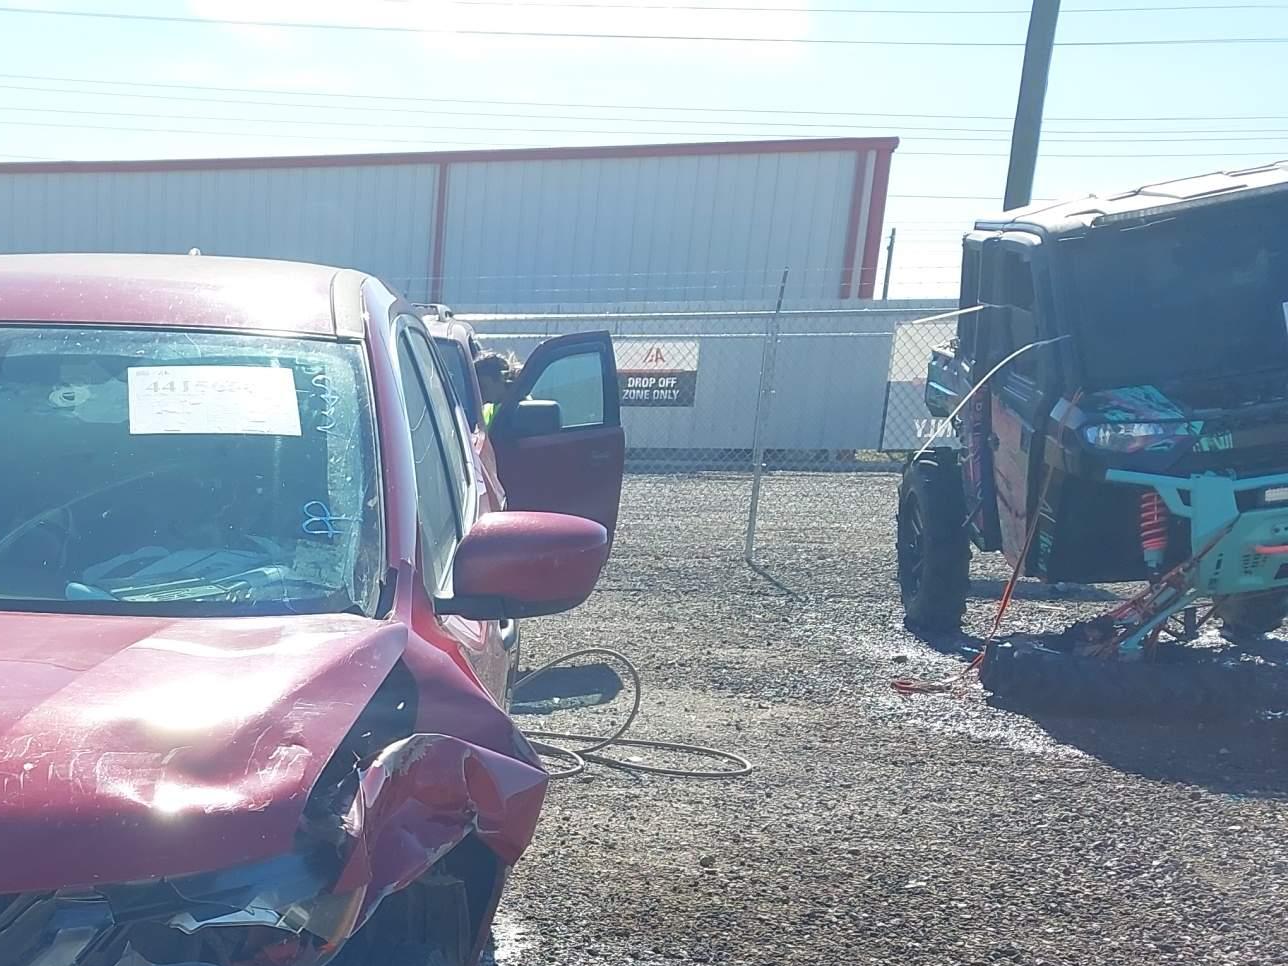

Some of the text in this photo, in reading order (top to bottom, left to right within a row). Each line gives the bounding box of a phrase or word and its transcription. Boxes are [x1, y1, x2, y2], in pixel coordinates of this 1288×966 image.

[627, 377, 677, 388] DROP OFF
[622, 389, 680, 400] ZONE ONLY
